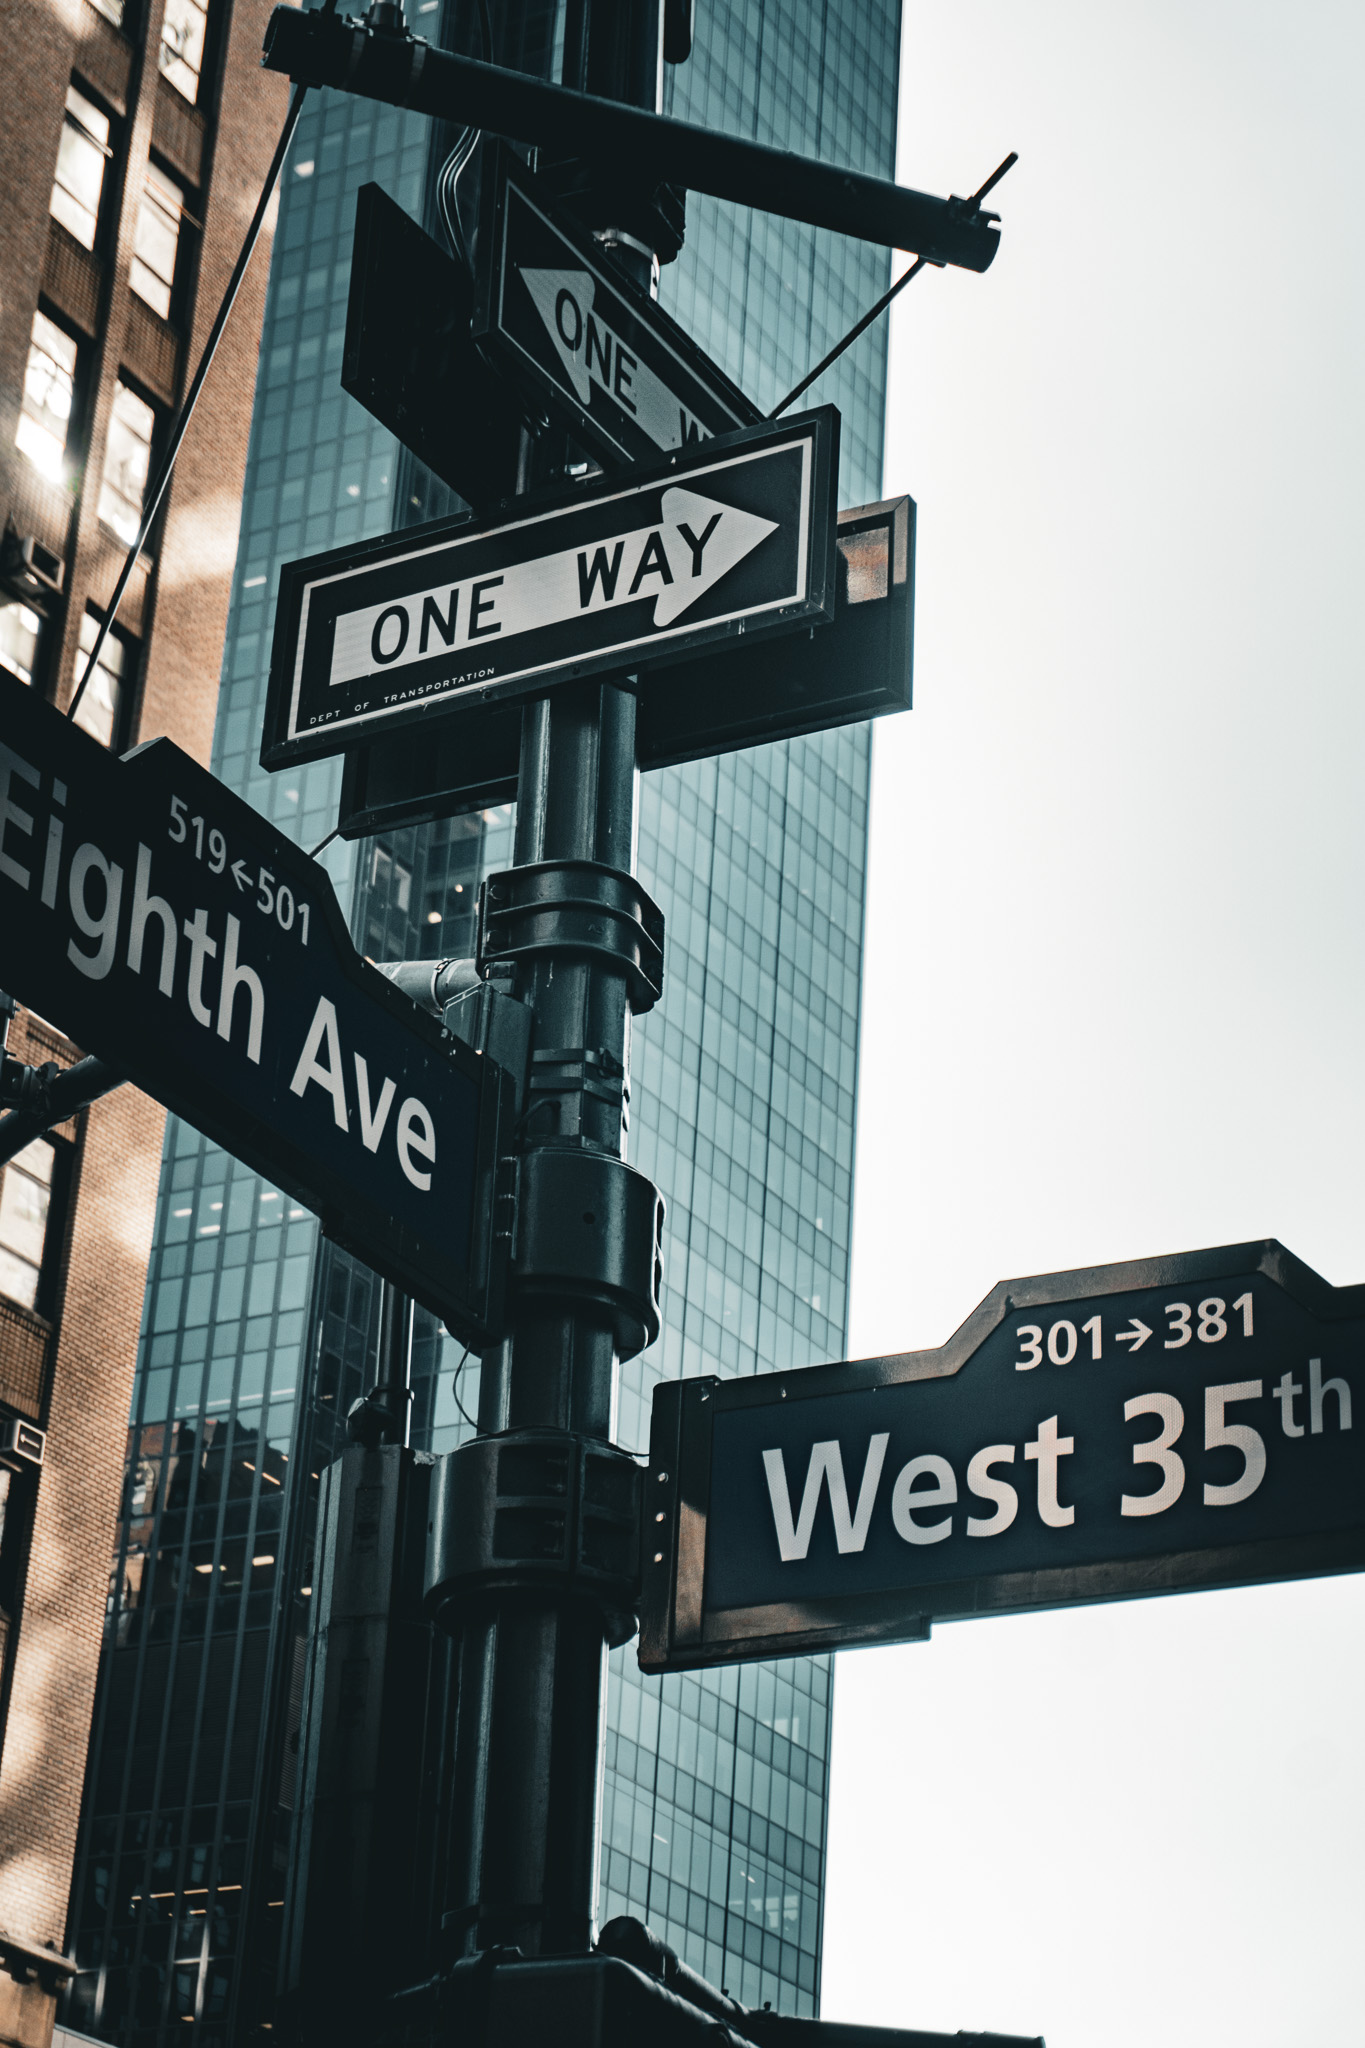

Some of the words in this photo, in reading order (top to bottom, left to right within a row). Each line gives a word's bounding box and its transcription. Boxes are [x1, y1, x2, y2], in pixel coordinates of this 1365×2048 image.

[555, 287, 638, 416] ONE
[371, 575, 505, 666] ONE
[577, 512, 723, 609] WAY
[309, 709, 341, 725] DEPT
[354, 701, 371, 717] OF
[383, 667, 495, 704] TRANSPORTATION
[168, 795, 227, 874] 519
[256, 866, 310, 946] 501
[0, 742, 265, 1065] Eighth
[289, 995, 436, 1192] Ave
[1014, 1315, 1102, 1371] 301
[1163, 1292, 1254, 1349] 381
[762, 1414, 1075, 1562] West
[1120, 1359, 1352, 1517] 35th
